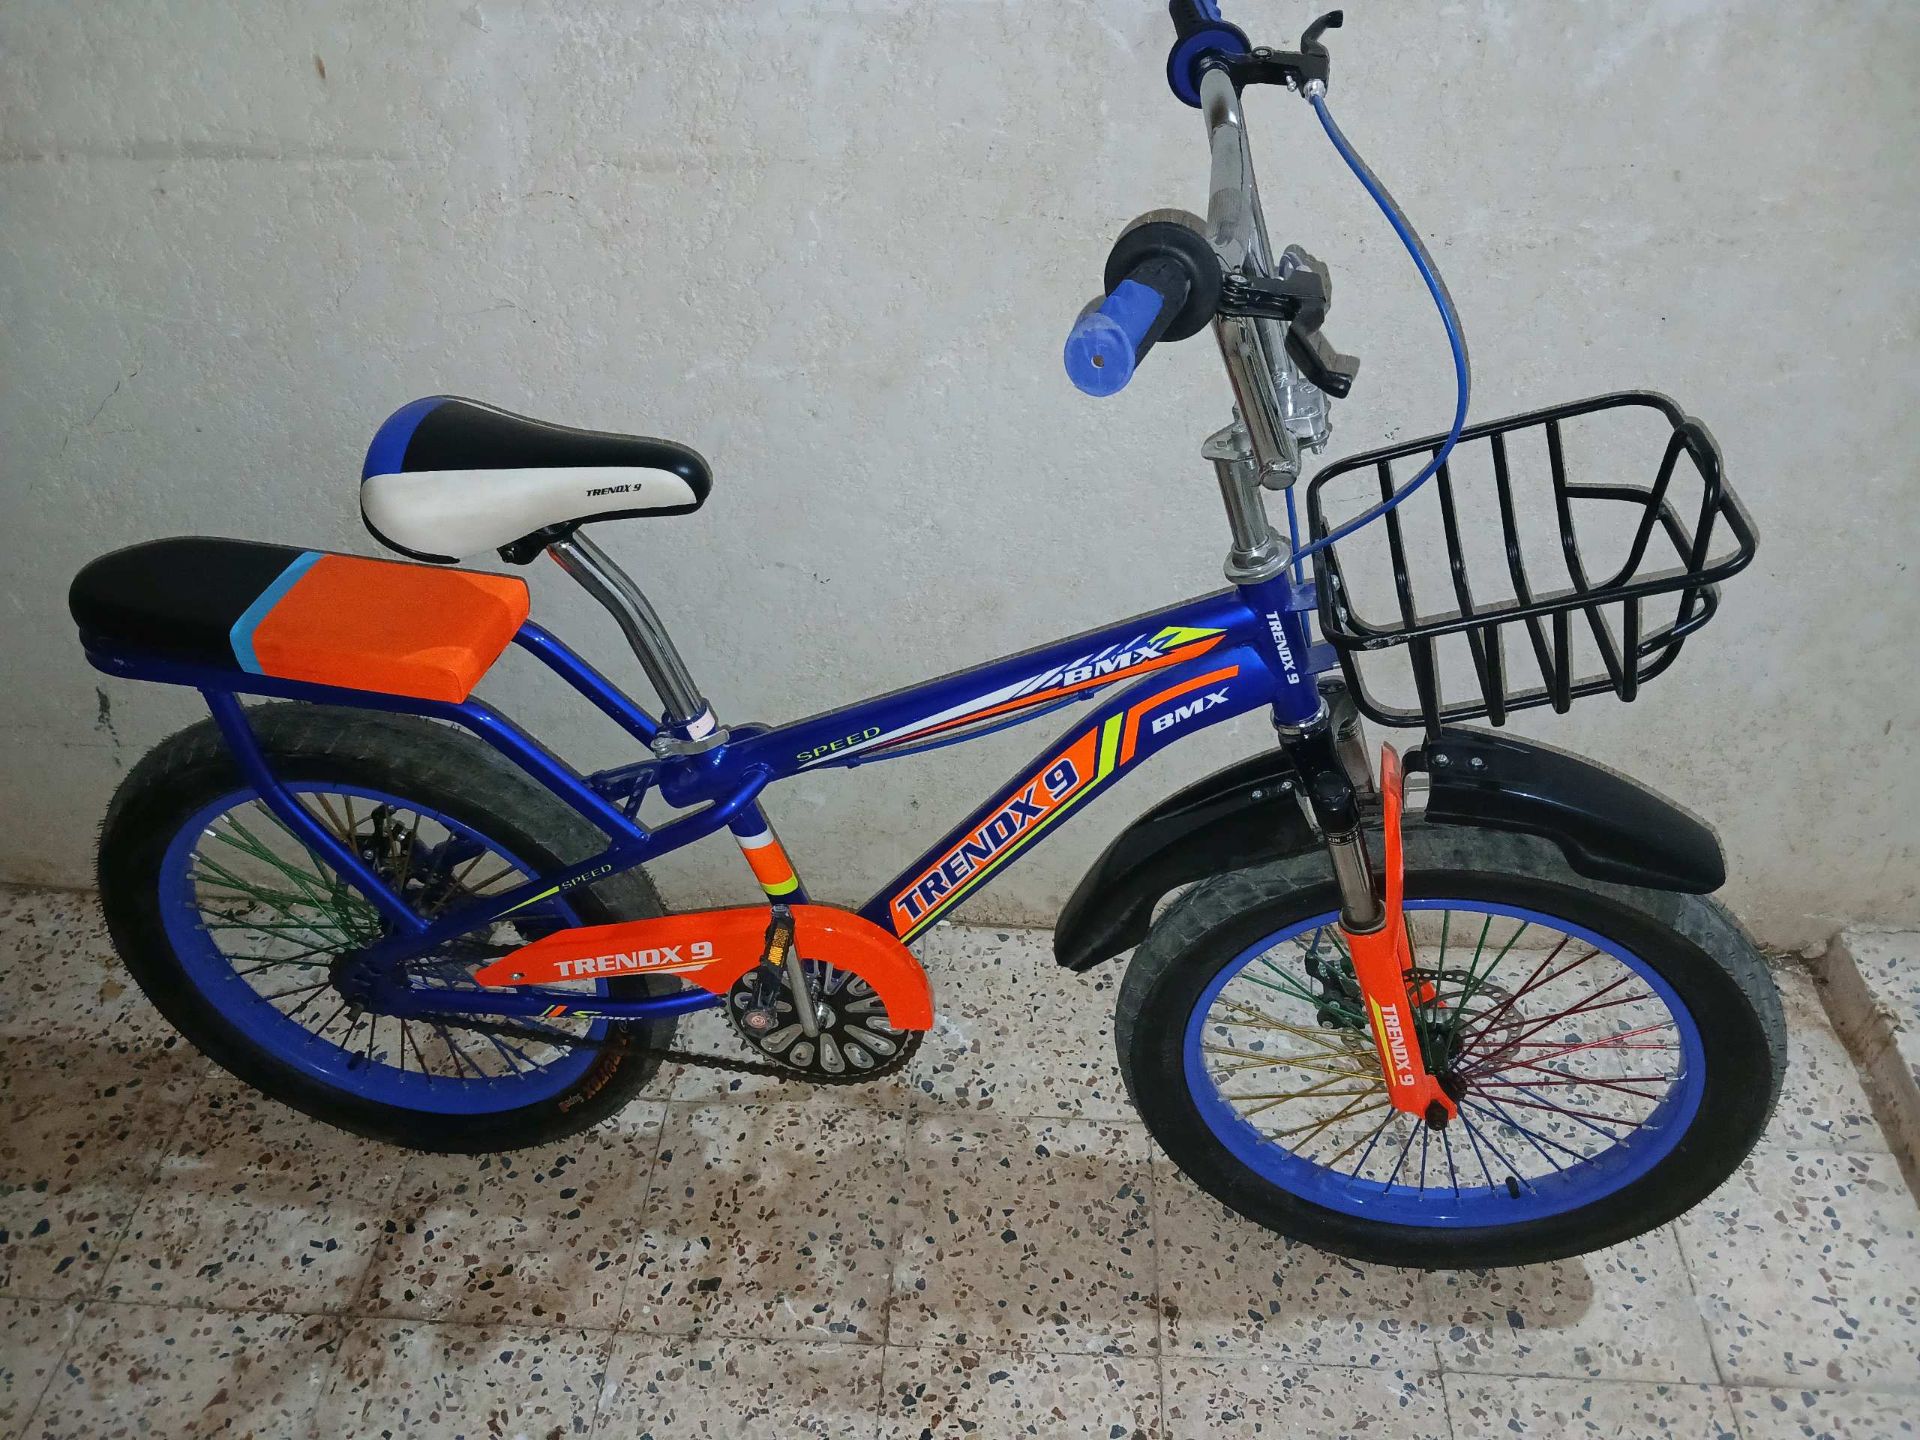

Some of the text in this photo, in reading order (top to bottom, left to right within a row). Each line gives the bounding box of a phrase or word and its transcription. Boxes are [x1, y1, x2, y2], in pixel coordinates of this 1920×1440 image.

[633, 483, 642, 492] 9
[1063, 639, 1168, 687] BMX
[1286, 673, 1300, 685] 9
[1151, 686, 1230, 735] BMX
[796, 726, 881, 762] SPEED
[1042, 757, 1080, 802] 9
[561, 864, 612, 890] SPEED
[690, 941, 713, 960] 9
[1399, 1074, 1415, 1087] 9
